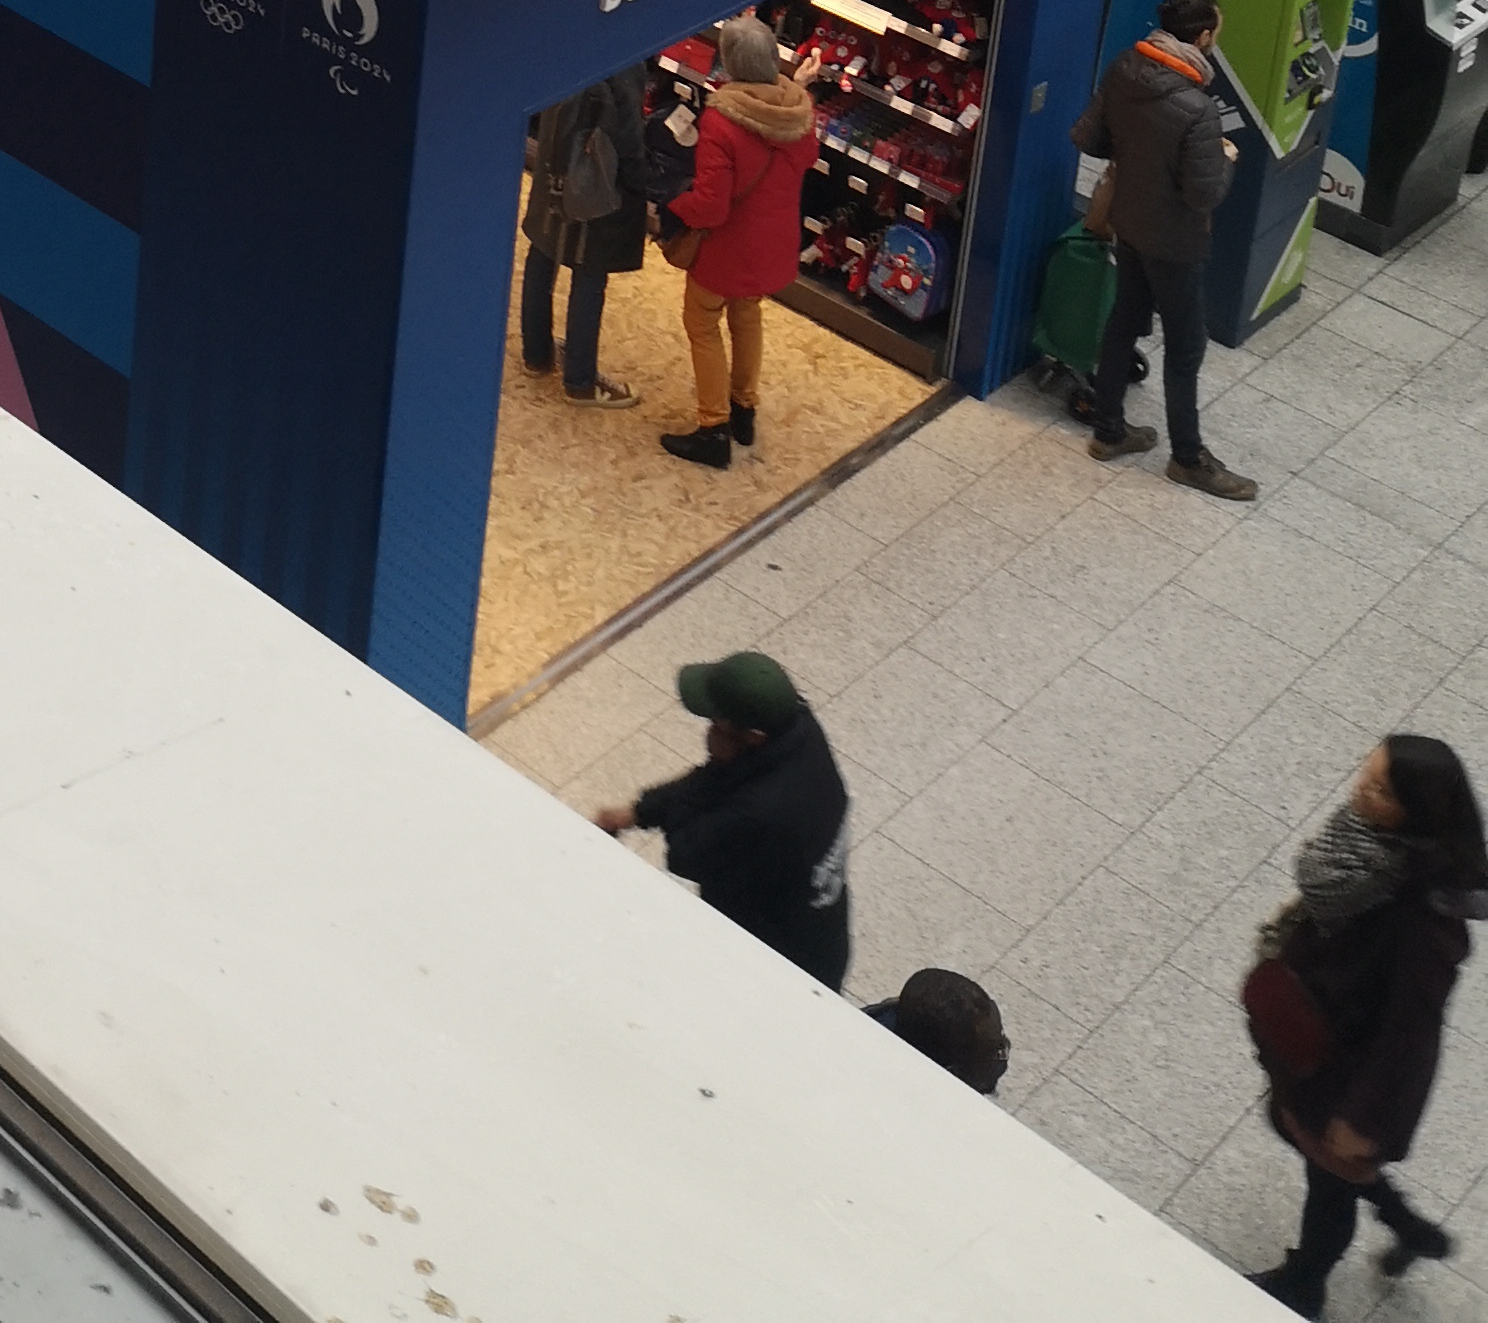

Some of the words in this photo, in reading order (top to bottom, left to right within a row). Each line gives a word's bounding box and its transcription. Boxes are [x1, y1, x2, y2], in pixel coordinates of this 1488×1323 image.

[301, 26, 346, 59] PARIS
[349, 50, 392, 84] 2024
[1318, 170, 1356, 201] Oui
